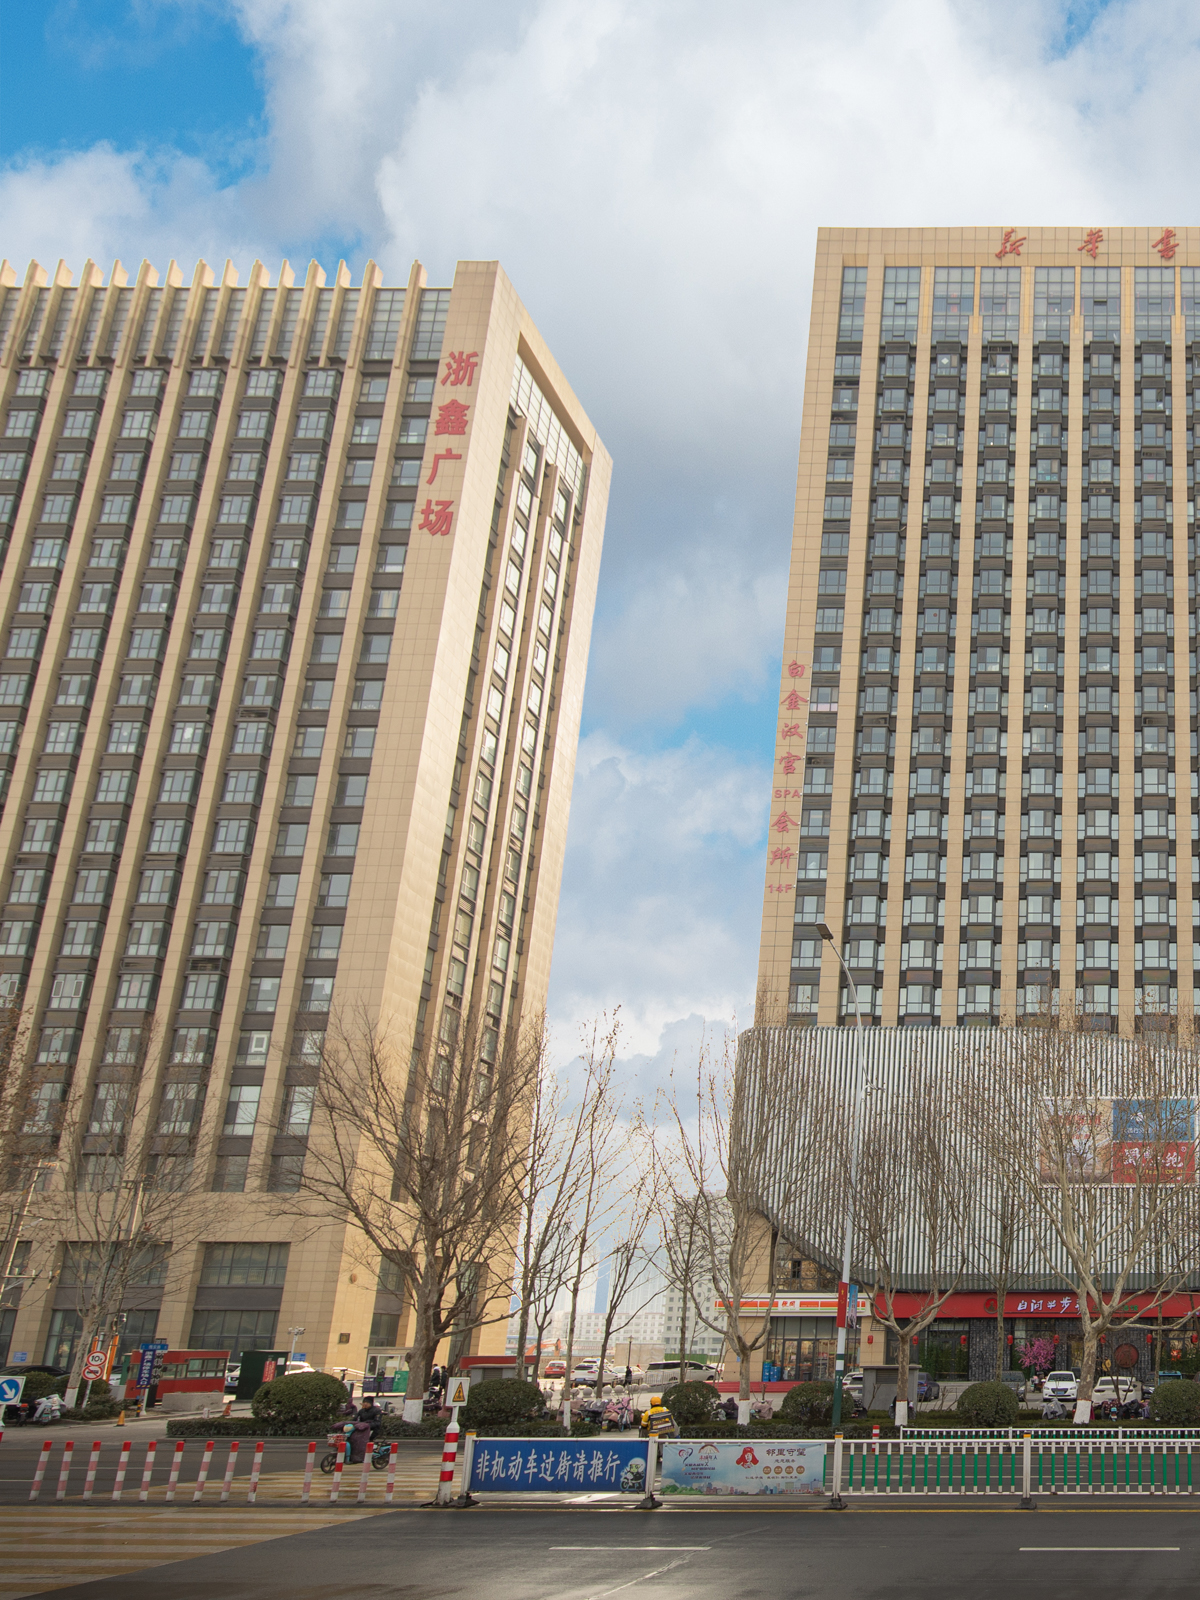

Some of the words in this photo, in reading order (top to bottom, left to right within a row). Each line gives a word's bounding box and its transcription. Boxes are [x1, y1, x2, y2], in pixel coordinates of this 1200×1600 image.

[418, 351, 479, 536] 浙鑫广场
[780, 660, 808, 775] 白金汉宫
[774, 789, 800, 798] SPA
[770, 811, 799, 869] 会所
[768, 884, 792, 893] 14F
[91, 1355, 103, 1363] 10t
[766, 1448, 806, 1457] 邻里守望
[475, 1448, 621, 1484] 非机动车过街请推行
